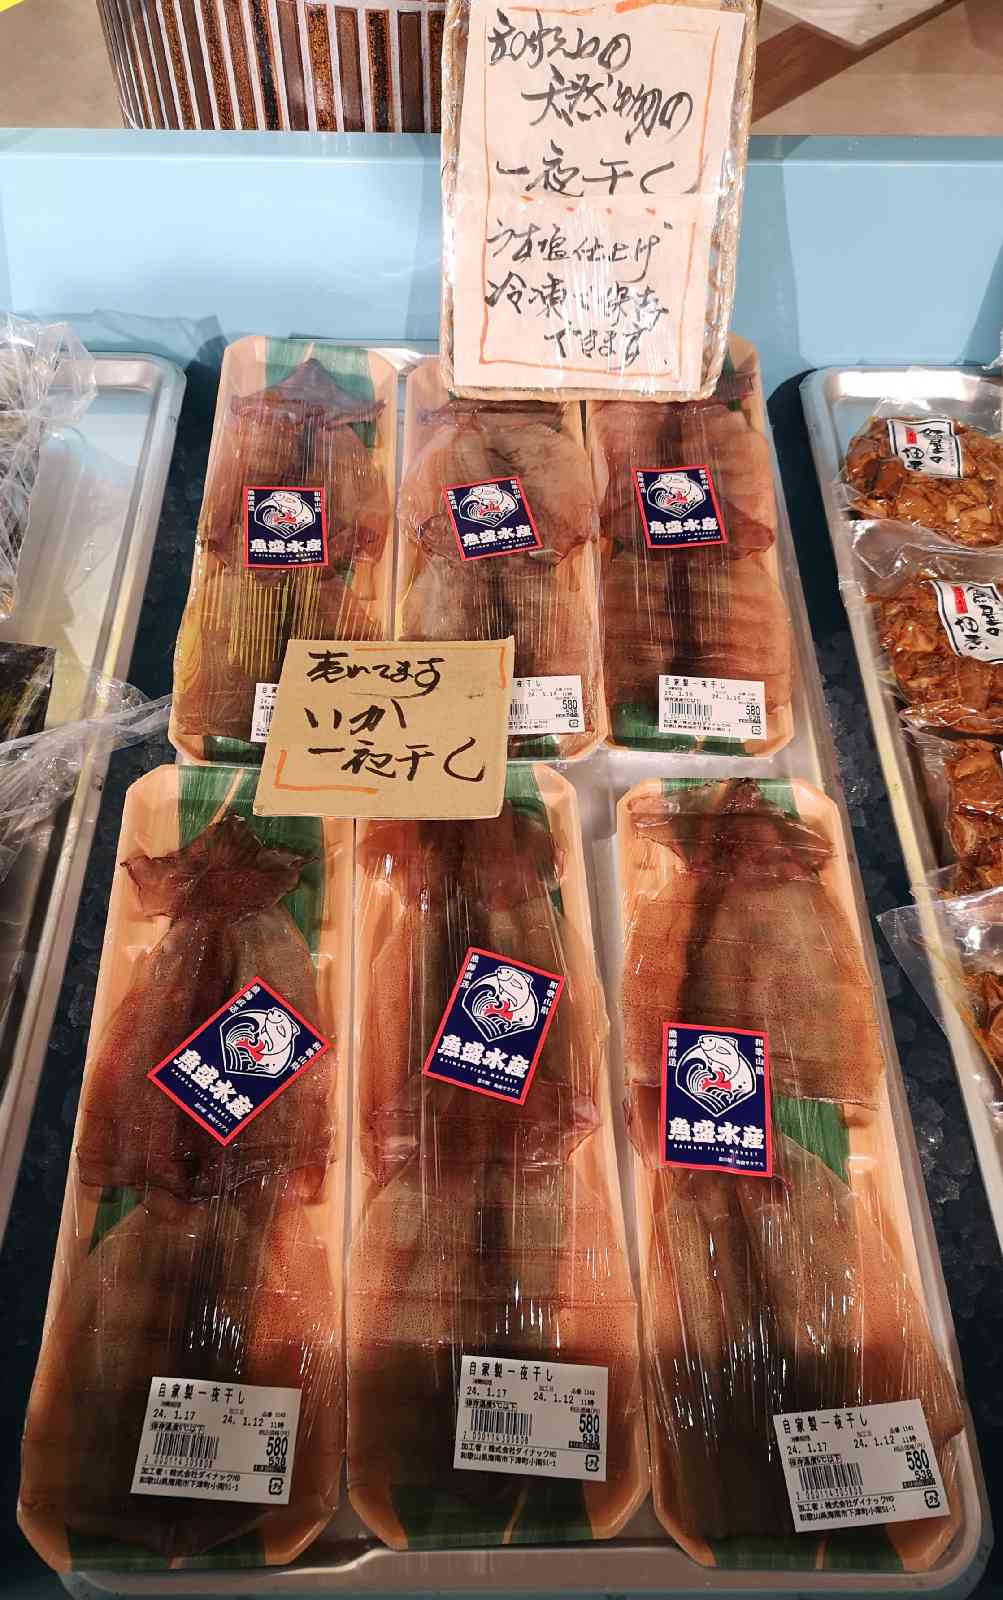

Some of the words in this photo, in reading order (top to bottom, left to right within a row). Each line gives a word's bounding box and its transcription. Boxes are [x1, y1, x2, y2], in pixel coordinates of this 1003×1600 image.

[307, 650, 445, 698] 売れてます
[562, 700, 578, 709] 580
[745, 705, 761, 715] 580
[304, 699, 407, 735] いか
[308, 737, 486, 782] 一夜干し
[437, 1034, 530, 1079] 魚盛水産
[173, 1049, 254, 1120] 魚盛水産
[668, 1116, 764, 1150] 魚盛水産
[469, 1361, 553, 1382] 自家製一夜干し
[158, 1383, 245, 1405] 自家製一夜干し
[579, 1414, 600, 1433] 580
[783, 1413, 867, 1434] 自家製一夜干し
[266, 1437, 288, 1456] 580
[906, 1449, 930, 1471] 580
[914, 1469, 932, 1481] 538
